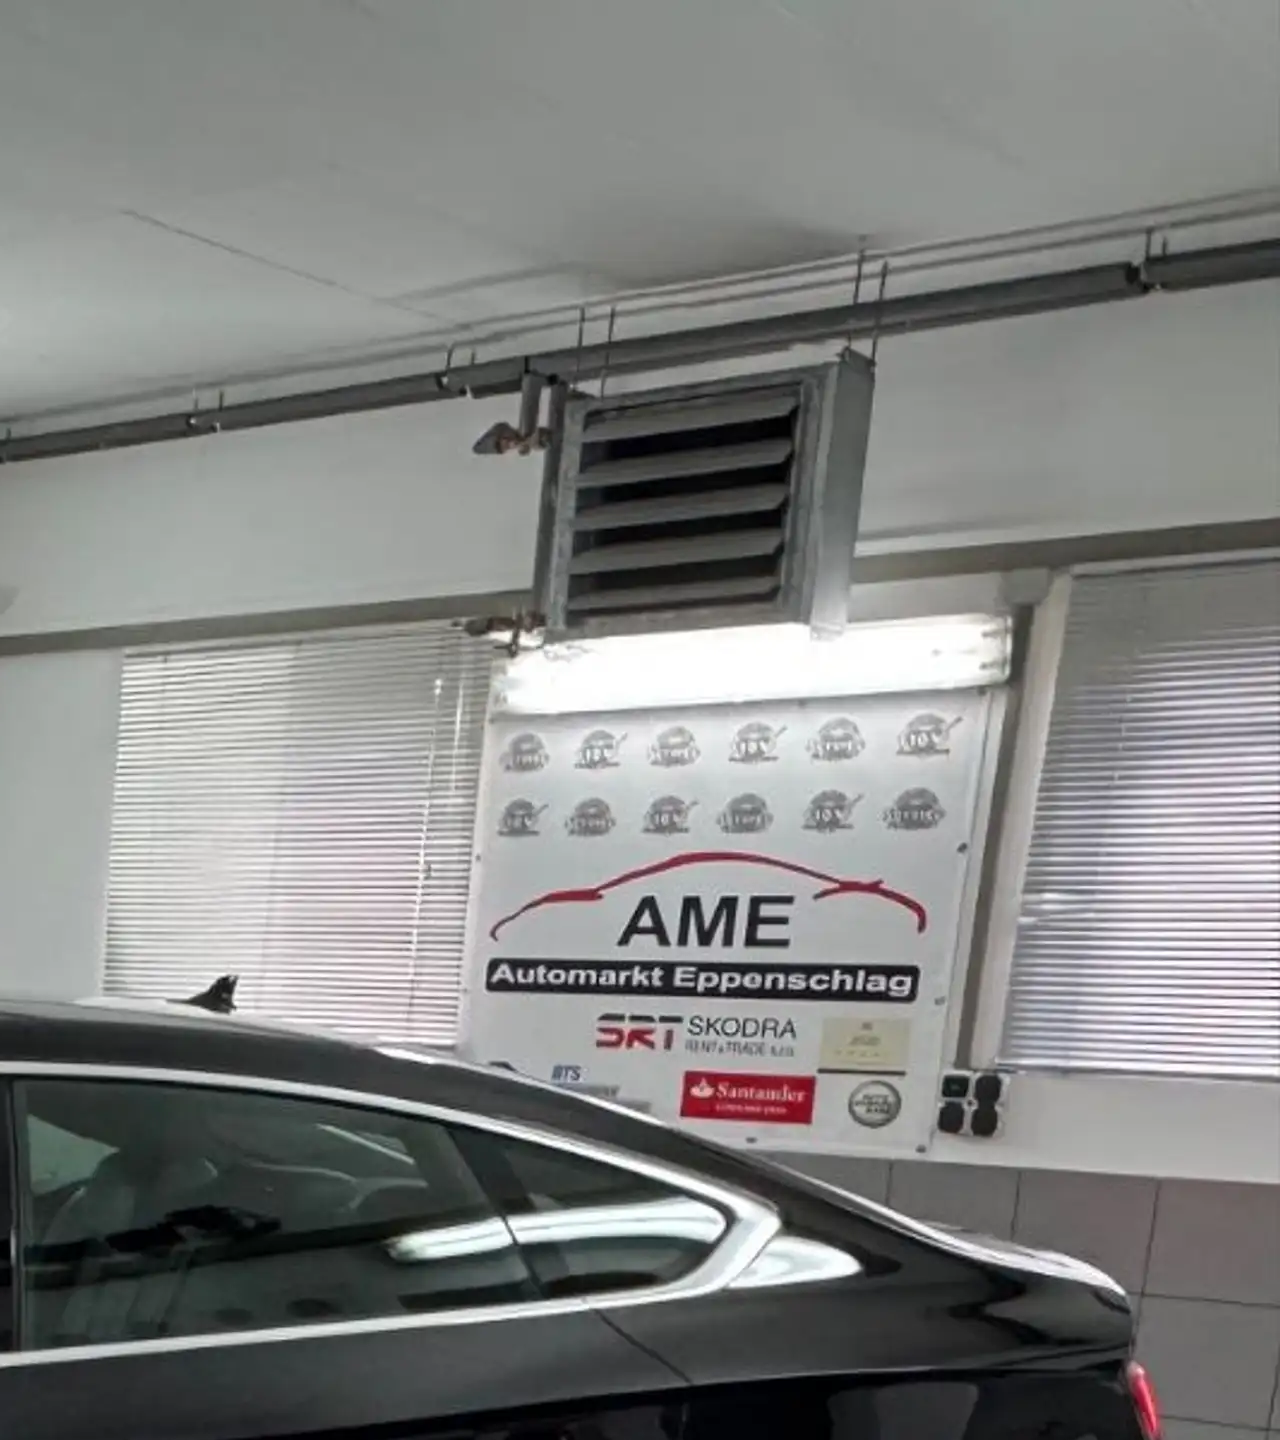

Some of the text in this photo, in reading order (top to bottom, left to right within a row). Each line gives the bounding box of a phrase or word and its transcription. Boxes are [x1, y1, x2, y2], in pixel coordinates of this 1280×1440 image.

[617, 895, 795, 947] AME
[490, 964, 913, 997] Automarkt Eppenschlag
[687, 1015, 798, 1039] SKODRA
[715, 1081, 809, 1103] Santander
